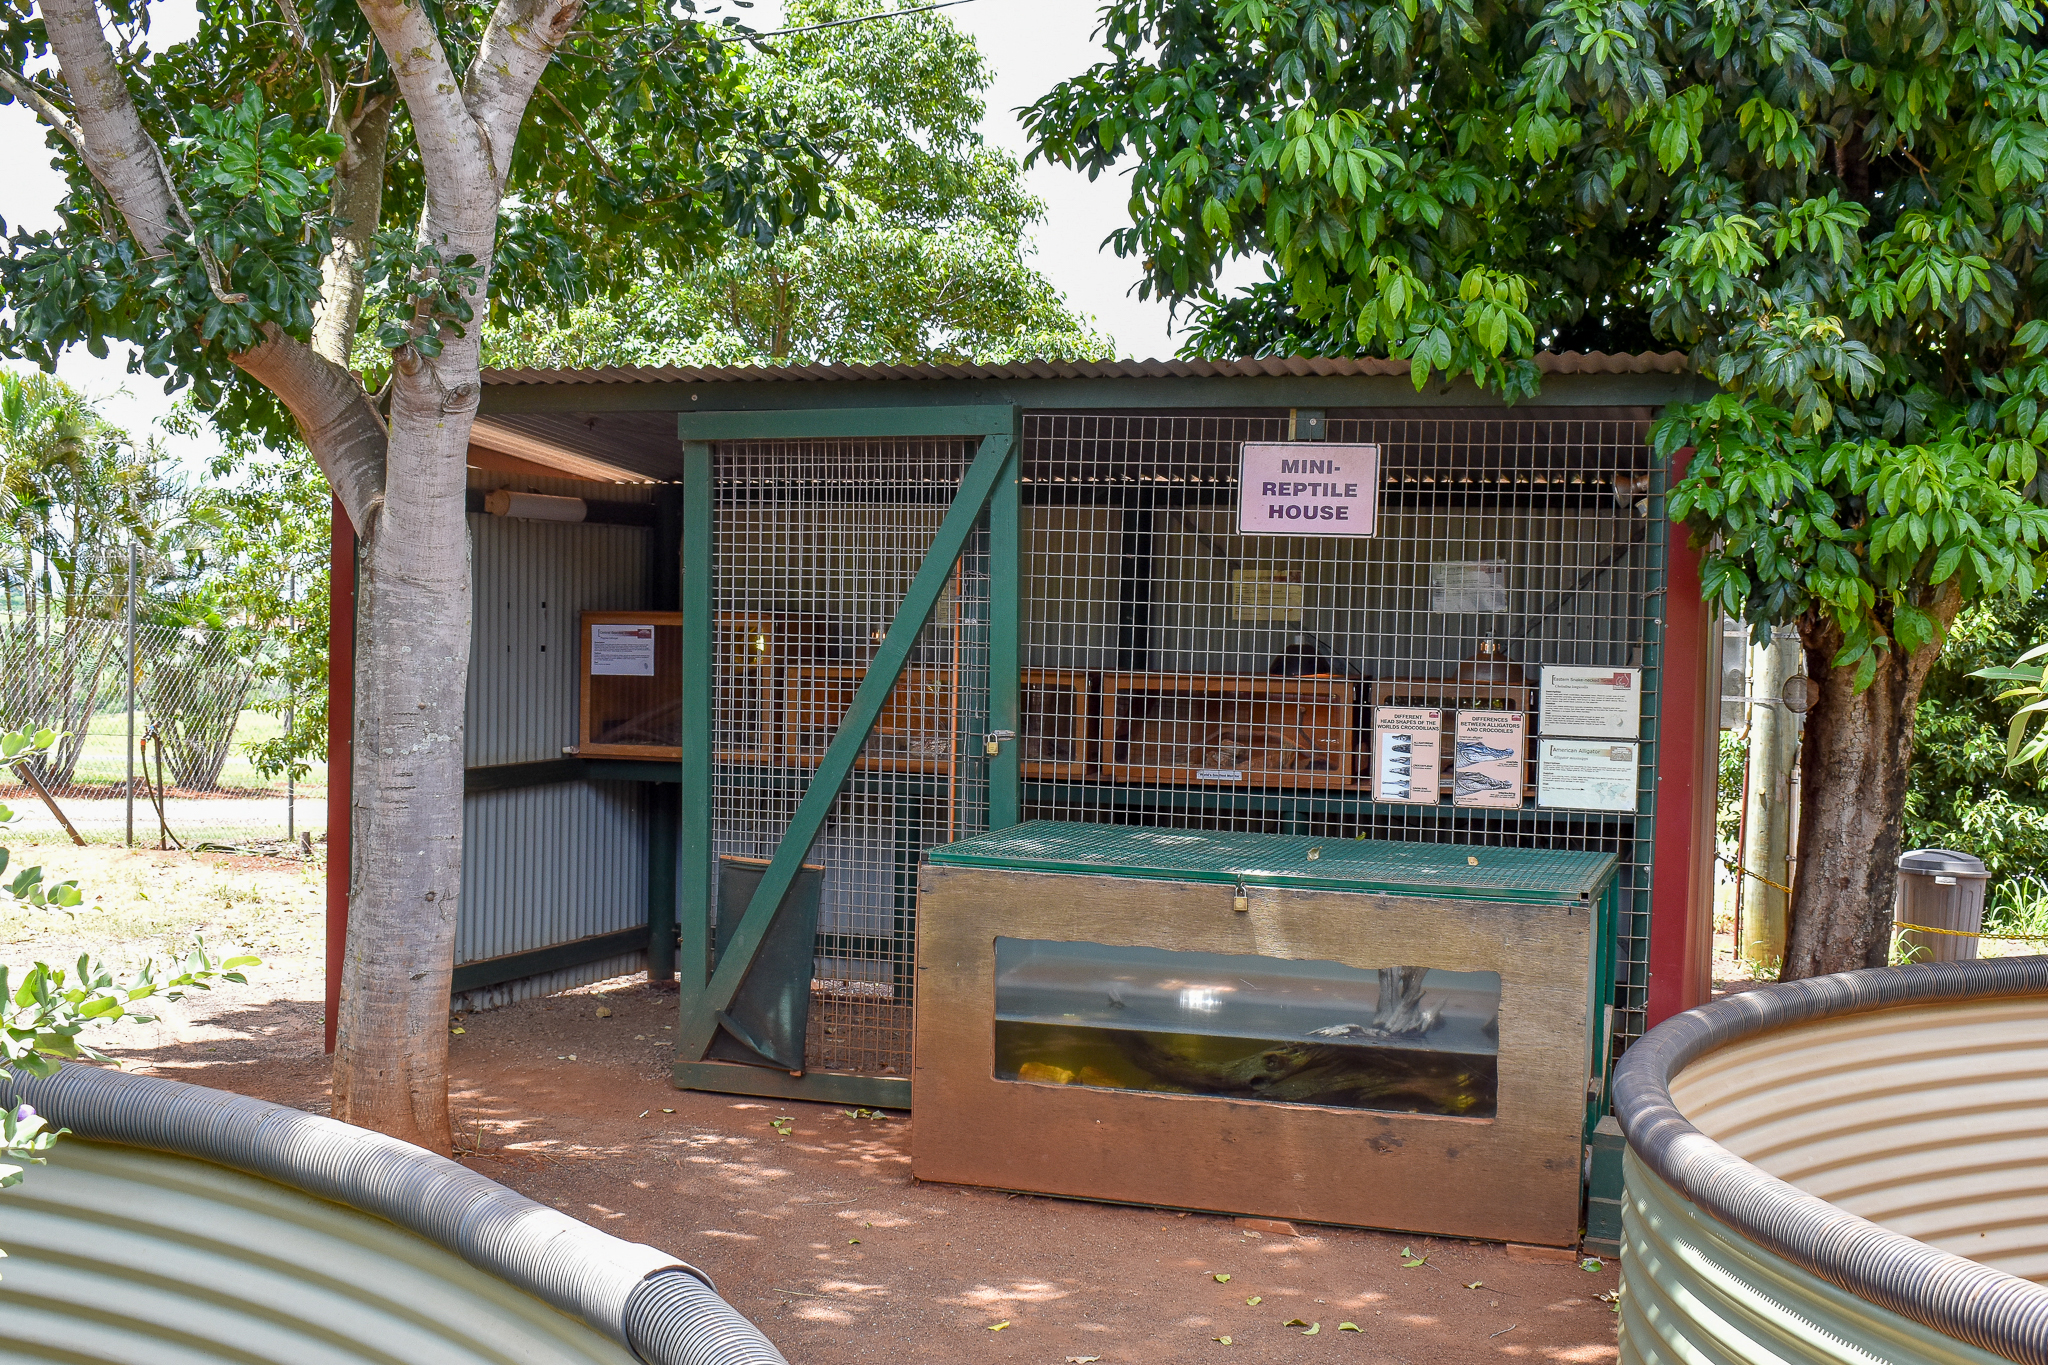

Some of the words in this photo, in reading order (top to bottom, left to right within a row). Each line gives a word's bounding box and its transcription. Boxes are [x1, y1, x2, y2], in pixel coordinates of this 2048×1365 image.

[1281, 459, 1341, 474] MINI-
[1262, 481, 1358, 498] REPTILE
[1268, 504, 1349, 520] HOUSE
